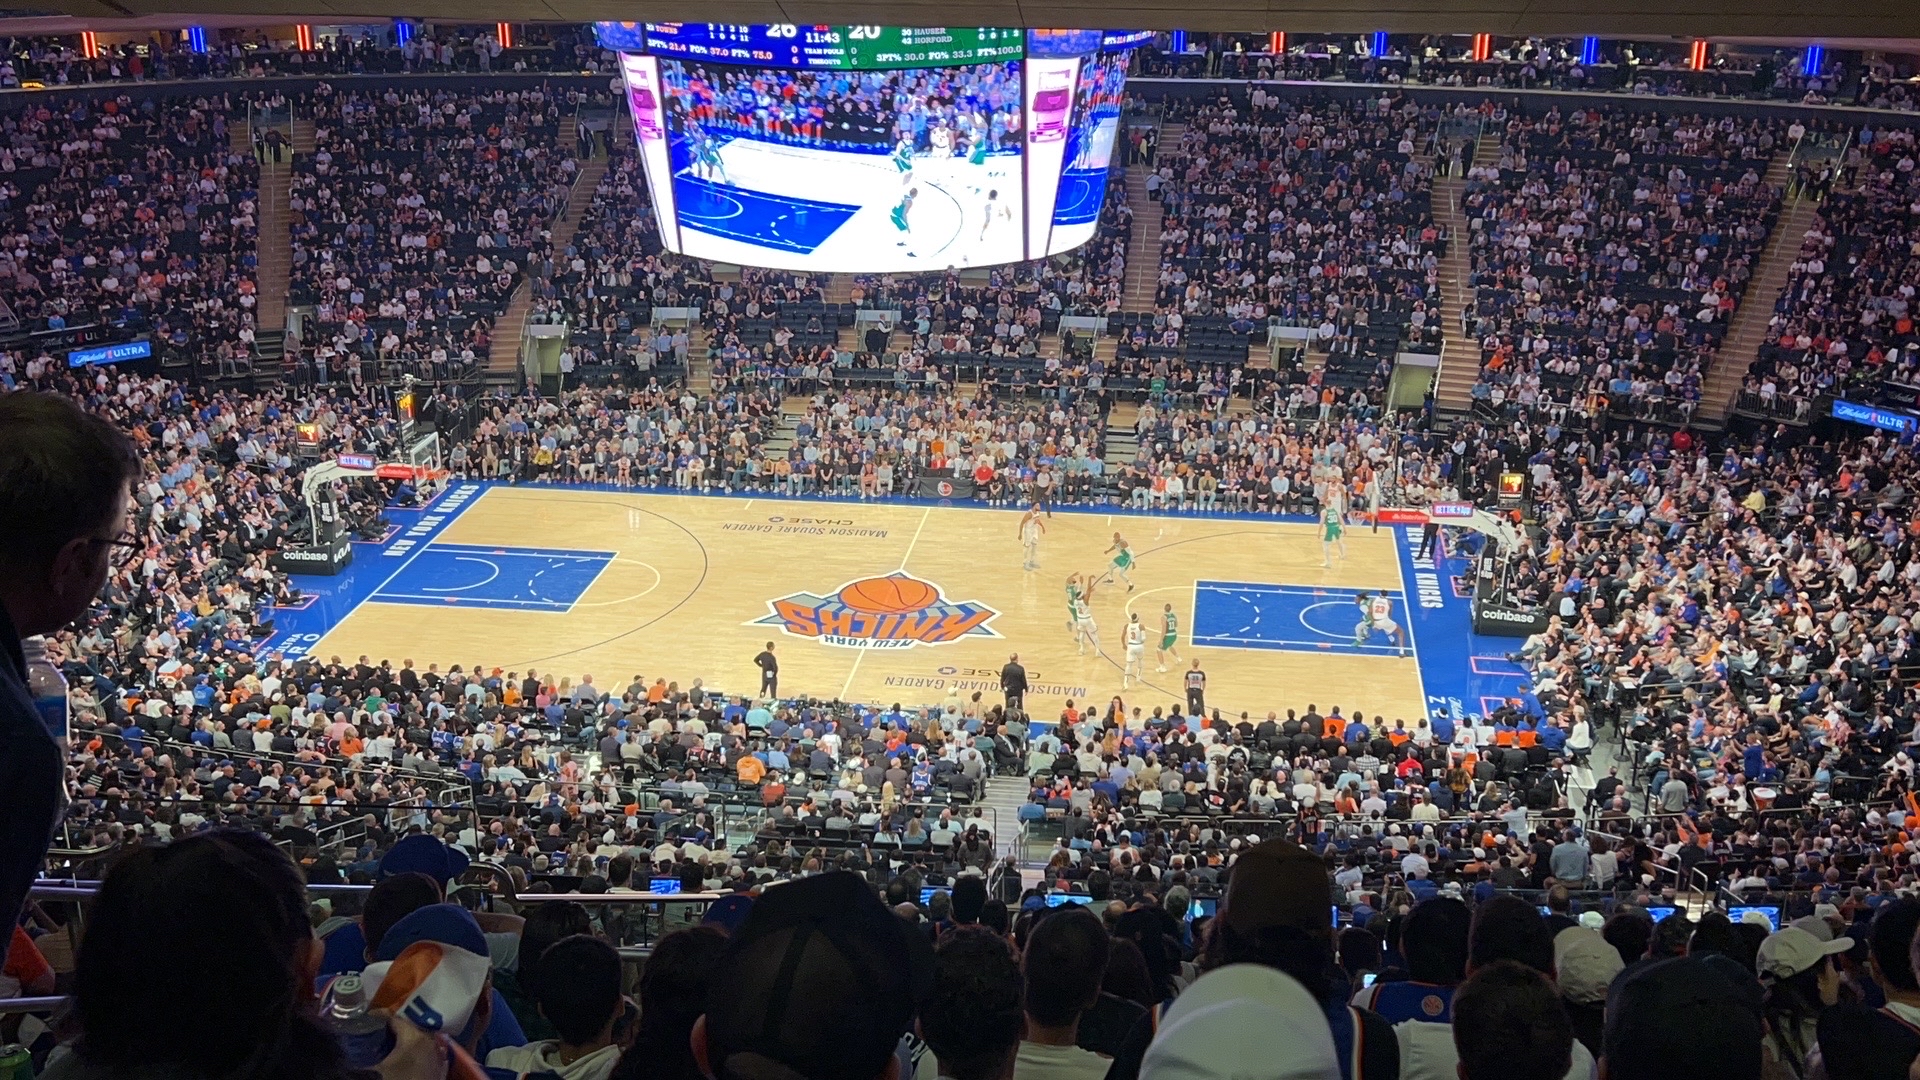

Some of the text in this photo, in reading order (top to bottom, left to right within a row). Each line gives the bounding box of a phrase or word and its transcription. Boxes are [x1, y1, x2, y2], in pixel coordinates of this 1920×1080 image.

[805, 33, 840, 43] 11:43
[849, 26, 881, 39] 20
[914, 28, 946, 36] HAUSER
[914, 36, 953, 44] HORFORD
[669, 42, 687, 51] 21.4
[710, 47, 729, 56] 37.0
[752, 50, 773, 60] 75.0
[904, 53, 924, 61] 30.0
[928, 51, 949, 60] FG%
[952, 50, 972, 59] 33.3
[997, 45, 1022, 55] 100.0
[112, 346, 146, 358] ULTRA
[383, 485, 480, 556] NEW YORK KNICKS
[790, 518, 853, 526] CHASE
[722, 523, 888, 538] MADISON SQUARE GARDEN
[283, 551, 328, 561] coinbase
[1415, 573, 1444, 609] KNICKS
[1374, 605, 1386, 614] 23
[774, 601, 995, 644] KNICKS
[1482, 610, 1535, 623] coinbase
[275, 633, 304, 653] ULTRA
[824, 636, 915, 649] NEW YORK
[961, 667, 1042, 680] CASE
[884, 676, 946, 691] GARDEN
[1025, 683, 1087, 699] MADISO
